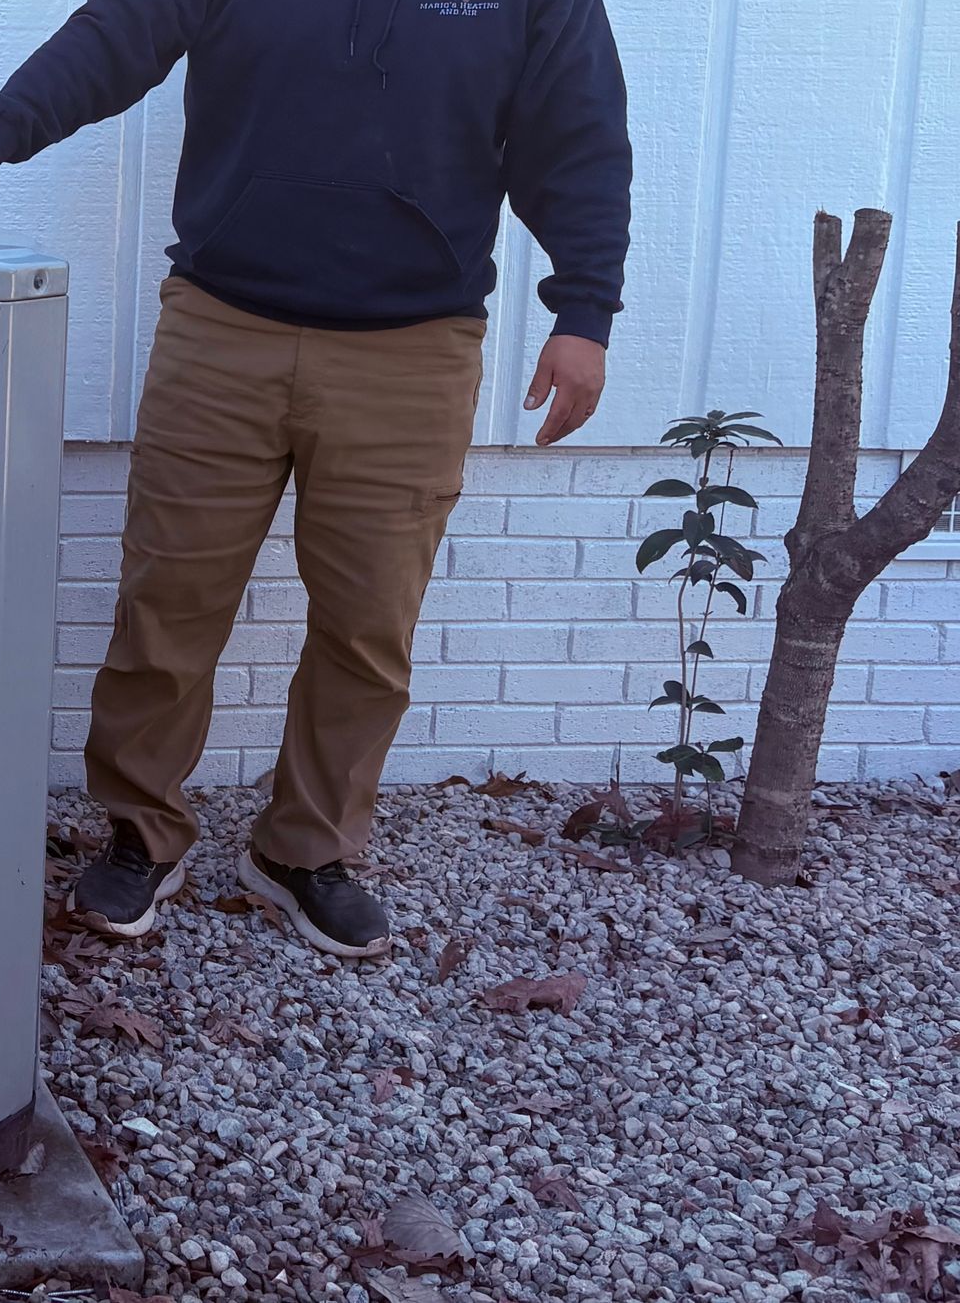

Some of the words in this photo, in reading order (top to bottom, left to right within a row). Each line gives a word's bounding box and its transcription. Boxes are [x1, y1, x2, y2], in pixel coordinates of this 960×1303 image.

[420, 2, 457, 10] MARIO'S
[460, 2, 499, 10] HEATING
[461, 8, 477, 16] AIR
